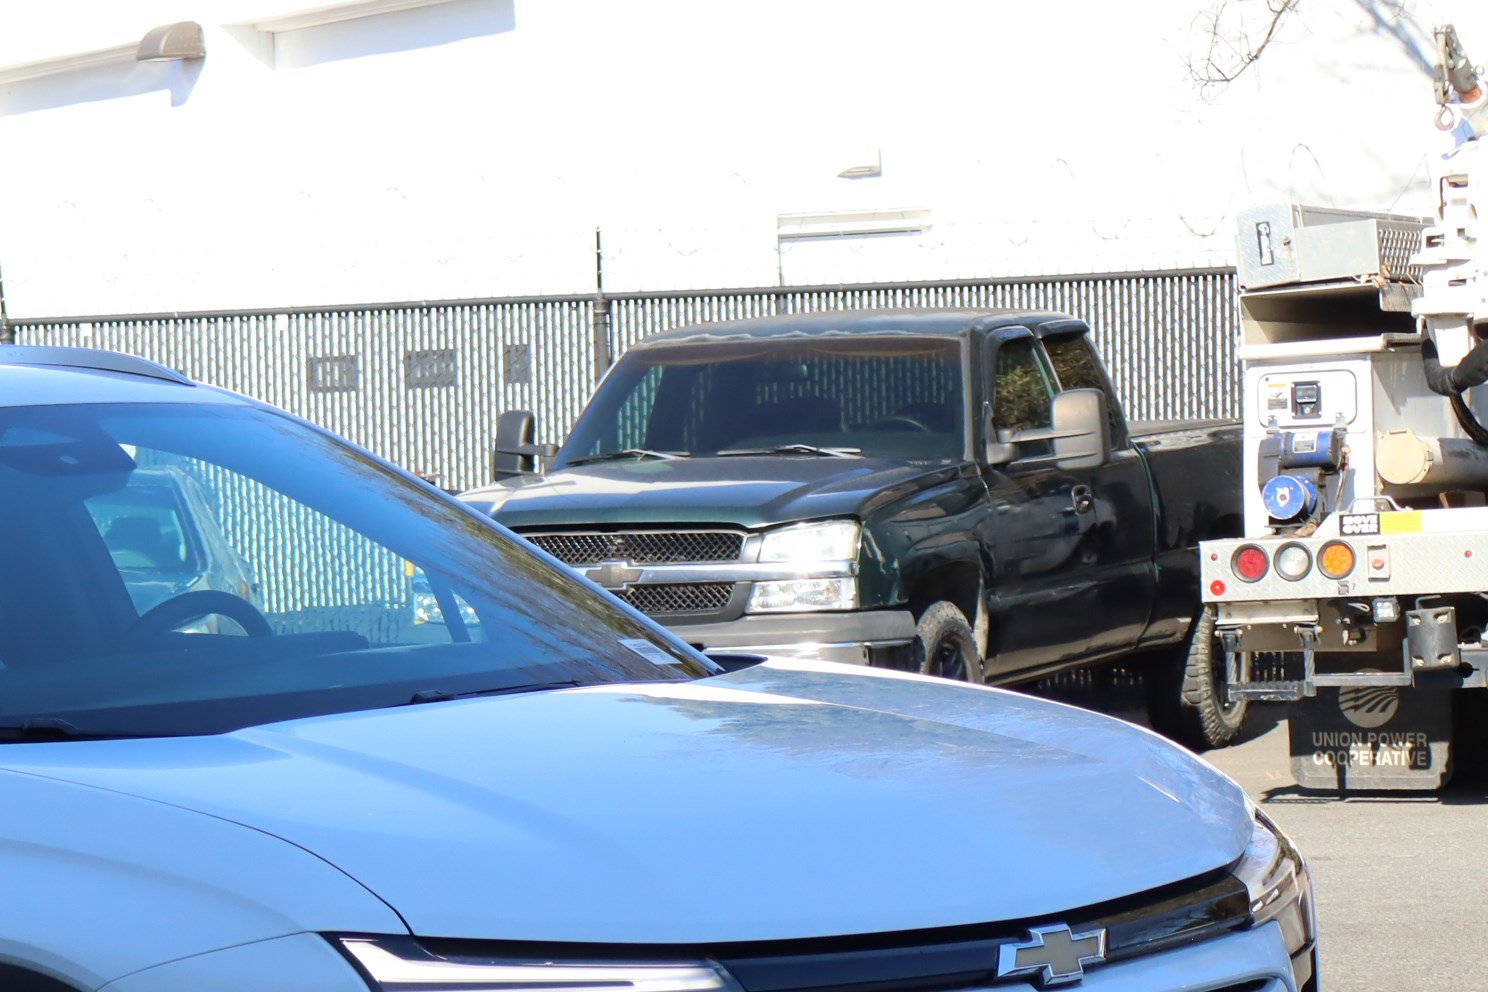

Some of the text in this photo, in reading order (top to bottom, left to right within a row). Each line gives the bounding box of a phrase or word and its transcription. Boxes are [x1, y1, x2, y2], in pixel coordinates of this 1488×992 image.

[1312, 732, 1427, 747] UNION POWER
[1312, 750, 1427, 766] COOPERATIVE
